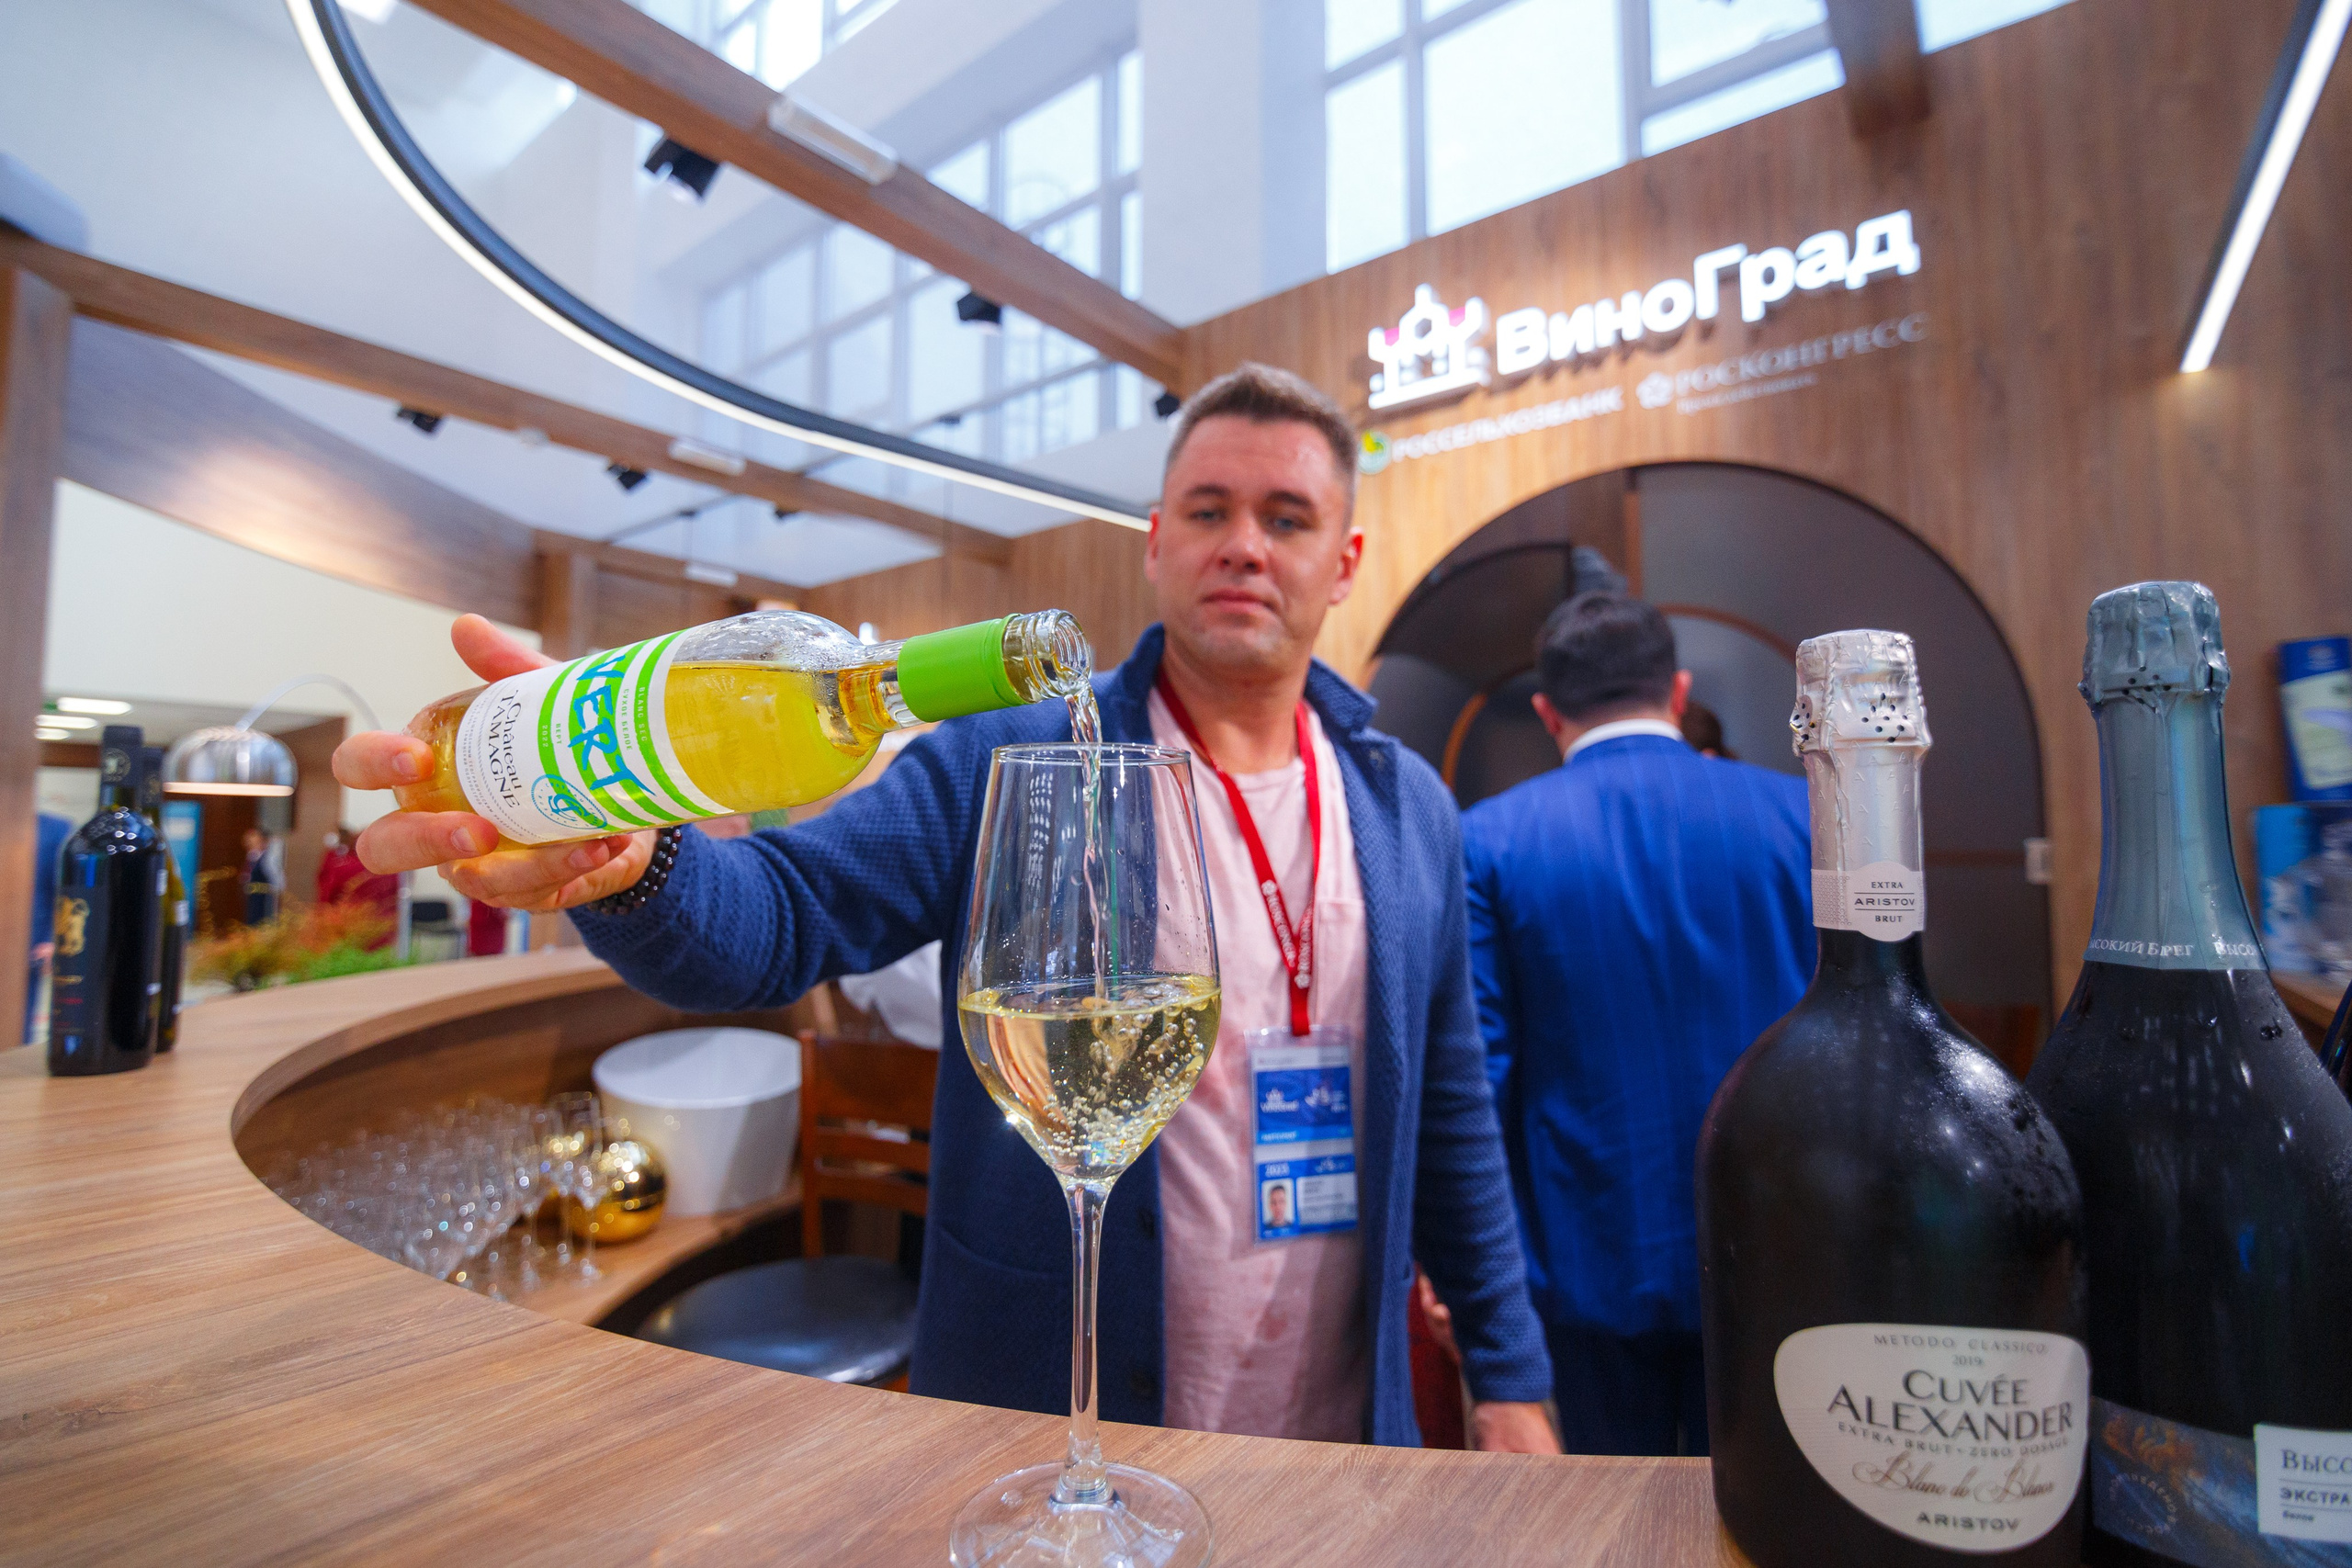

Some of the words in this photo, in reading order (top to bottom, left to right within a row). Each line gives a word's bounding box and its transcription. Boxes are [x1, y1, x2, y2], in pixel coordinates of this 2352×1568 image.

[1496, 209, 1921, 375] ВиноГрад
[503, 702, 523, 790] Château
[567, 654, 657, 797] VERT
[488, 690, 520, 808] TAMAGNE
[1854, 897, 1916, 906] ARISTOV
[1873, 1334, 1955, 1348] METODO
[1826, 1383, 2072, 1441] ALEXANDER
[1838, 1421, 1894, 1446] EXTRA
[2279, 1487, 2350, 1506] ЭКСТРА
[1917, 1512, 2021, 1532] ARISTOV
